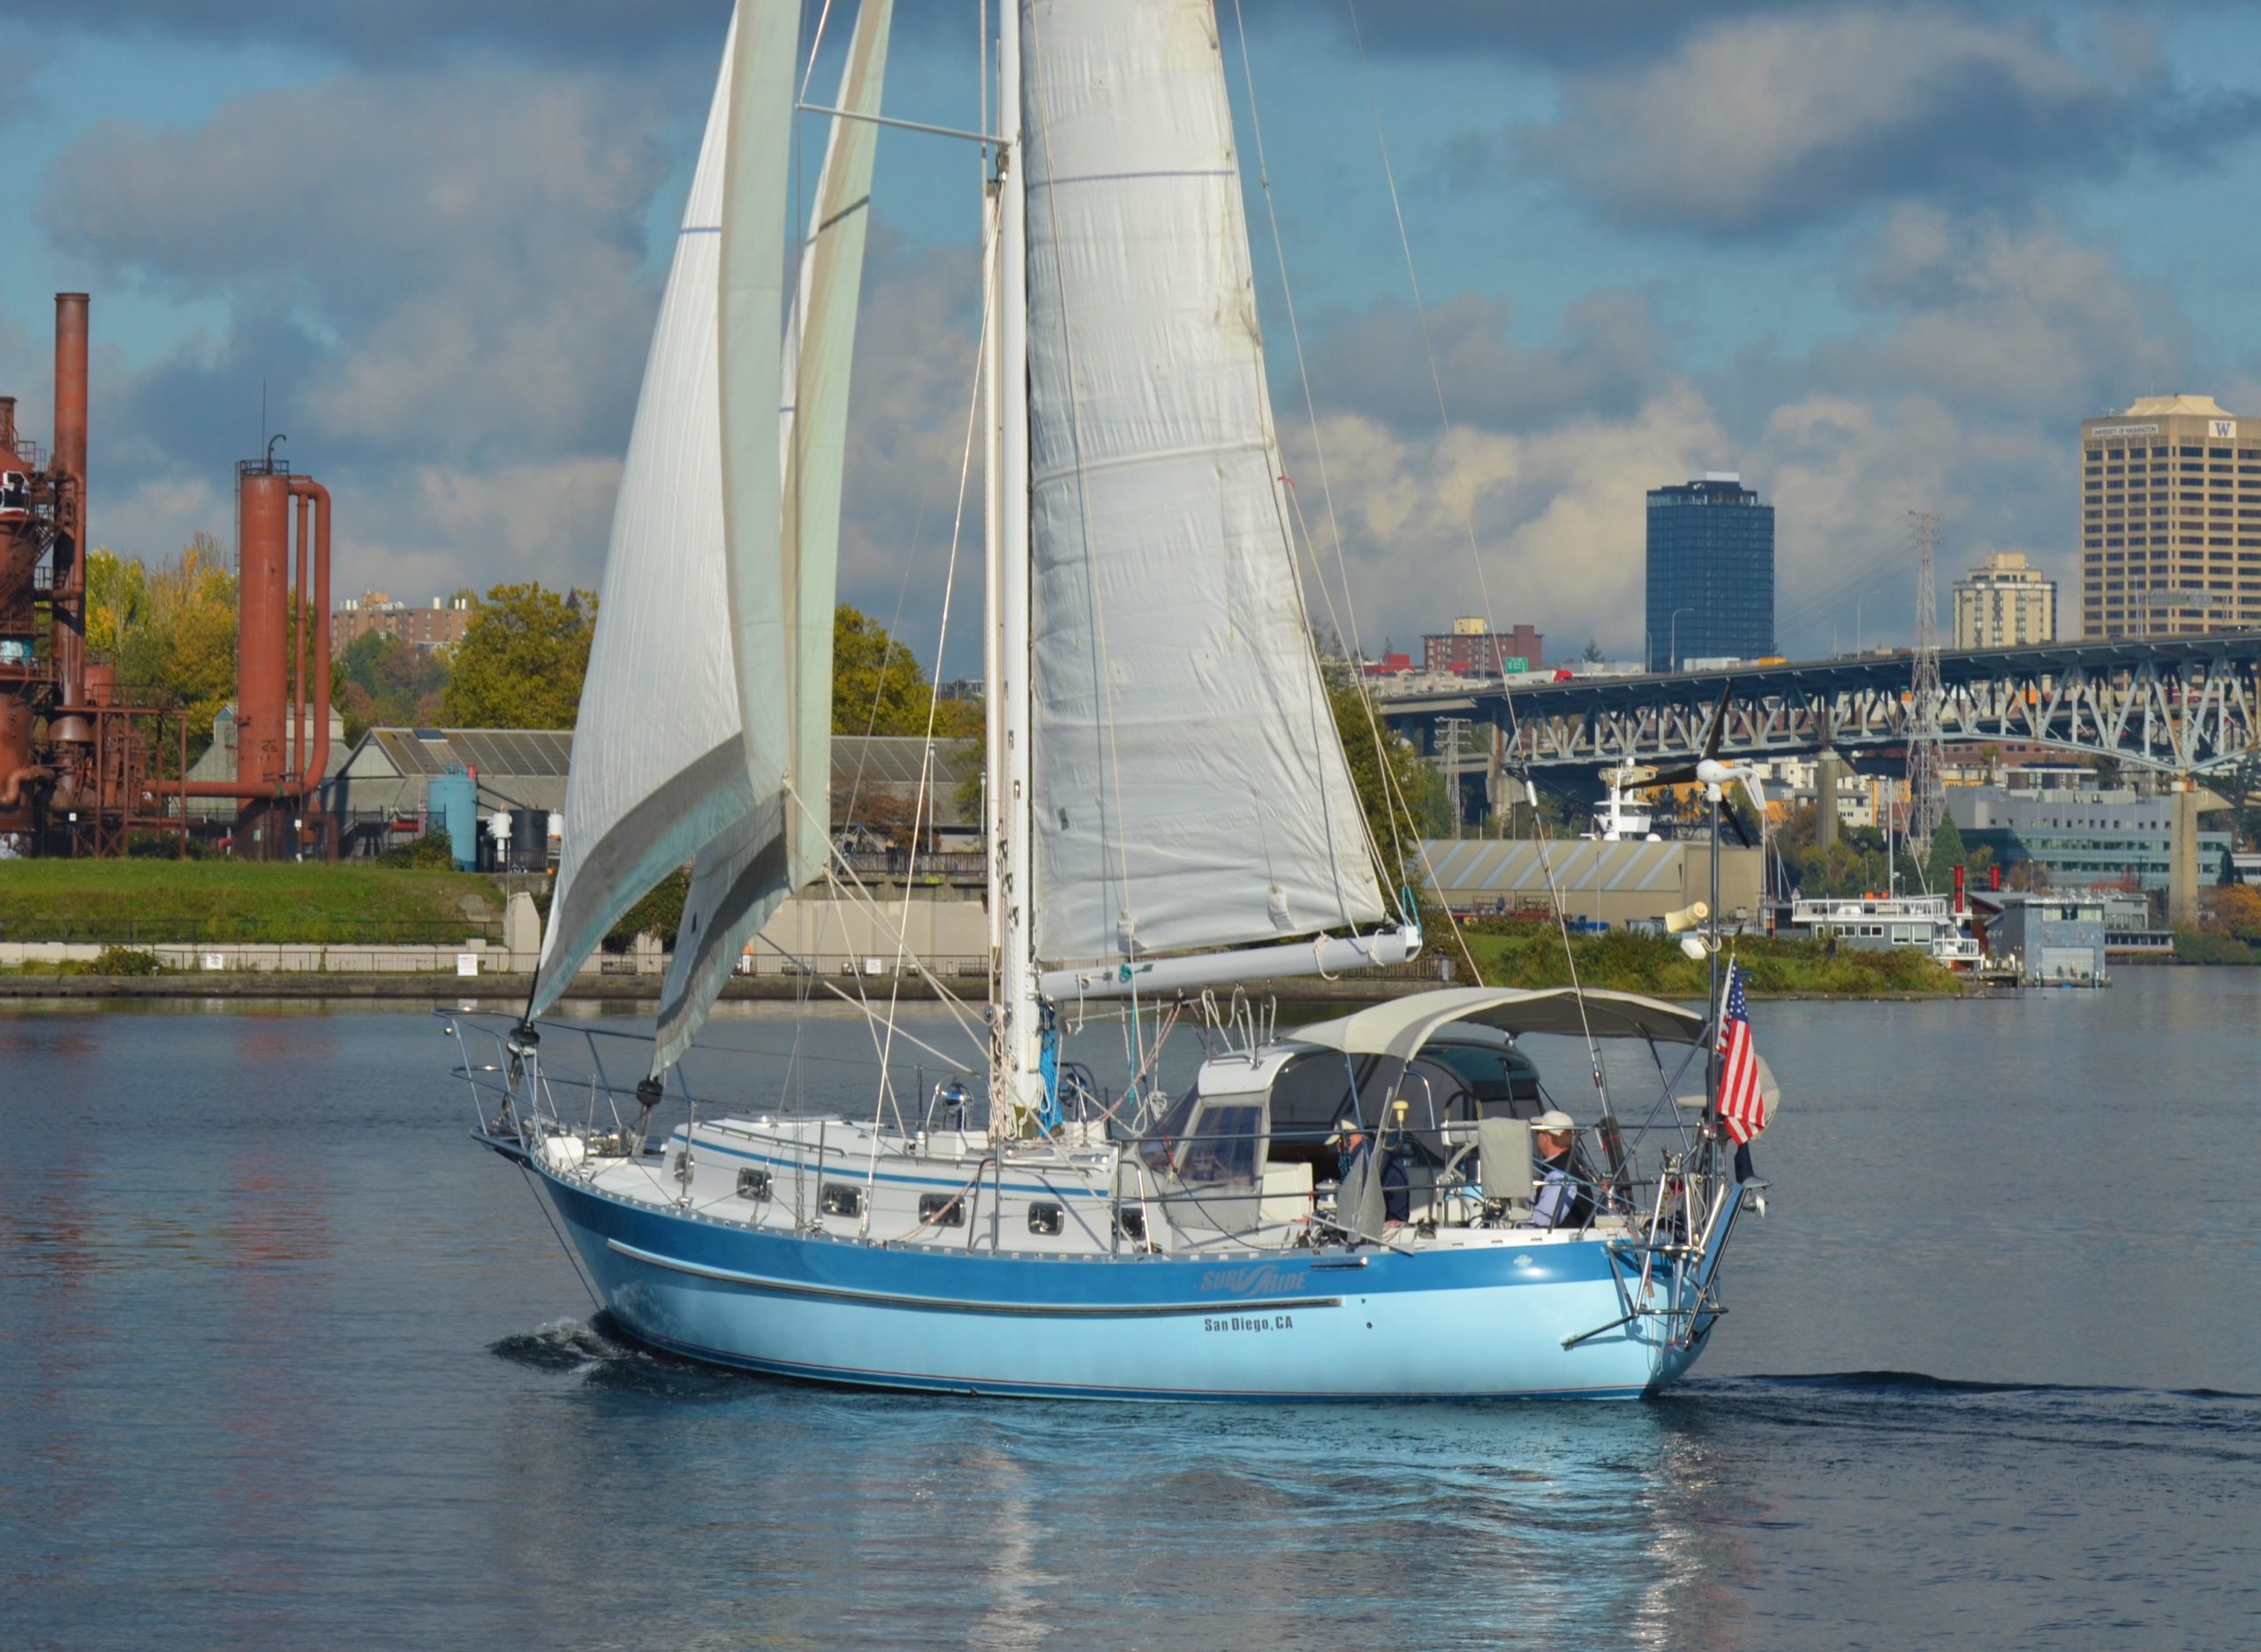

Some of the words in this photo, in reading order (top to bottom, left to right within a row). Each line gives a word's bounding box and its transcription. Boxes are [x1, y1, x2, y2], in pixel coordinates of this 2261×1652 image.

[2214, 422, 2231, 436] W
[1205, 1318, 1229, 1331] San
[1275, 1316, 1293, 1329] CA
